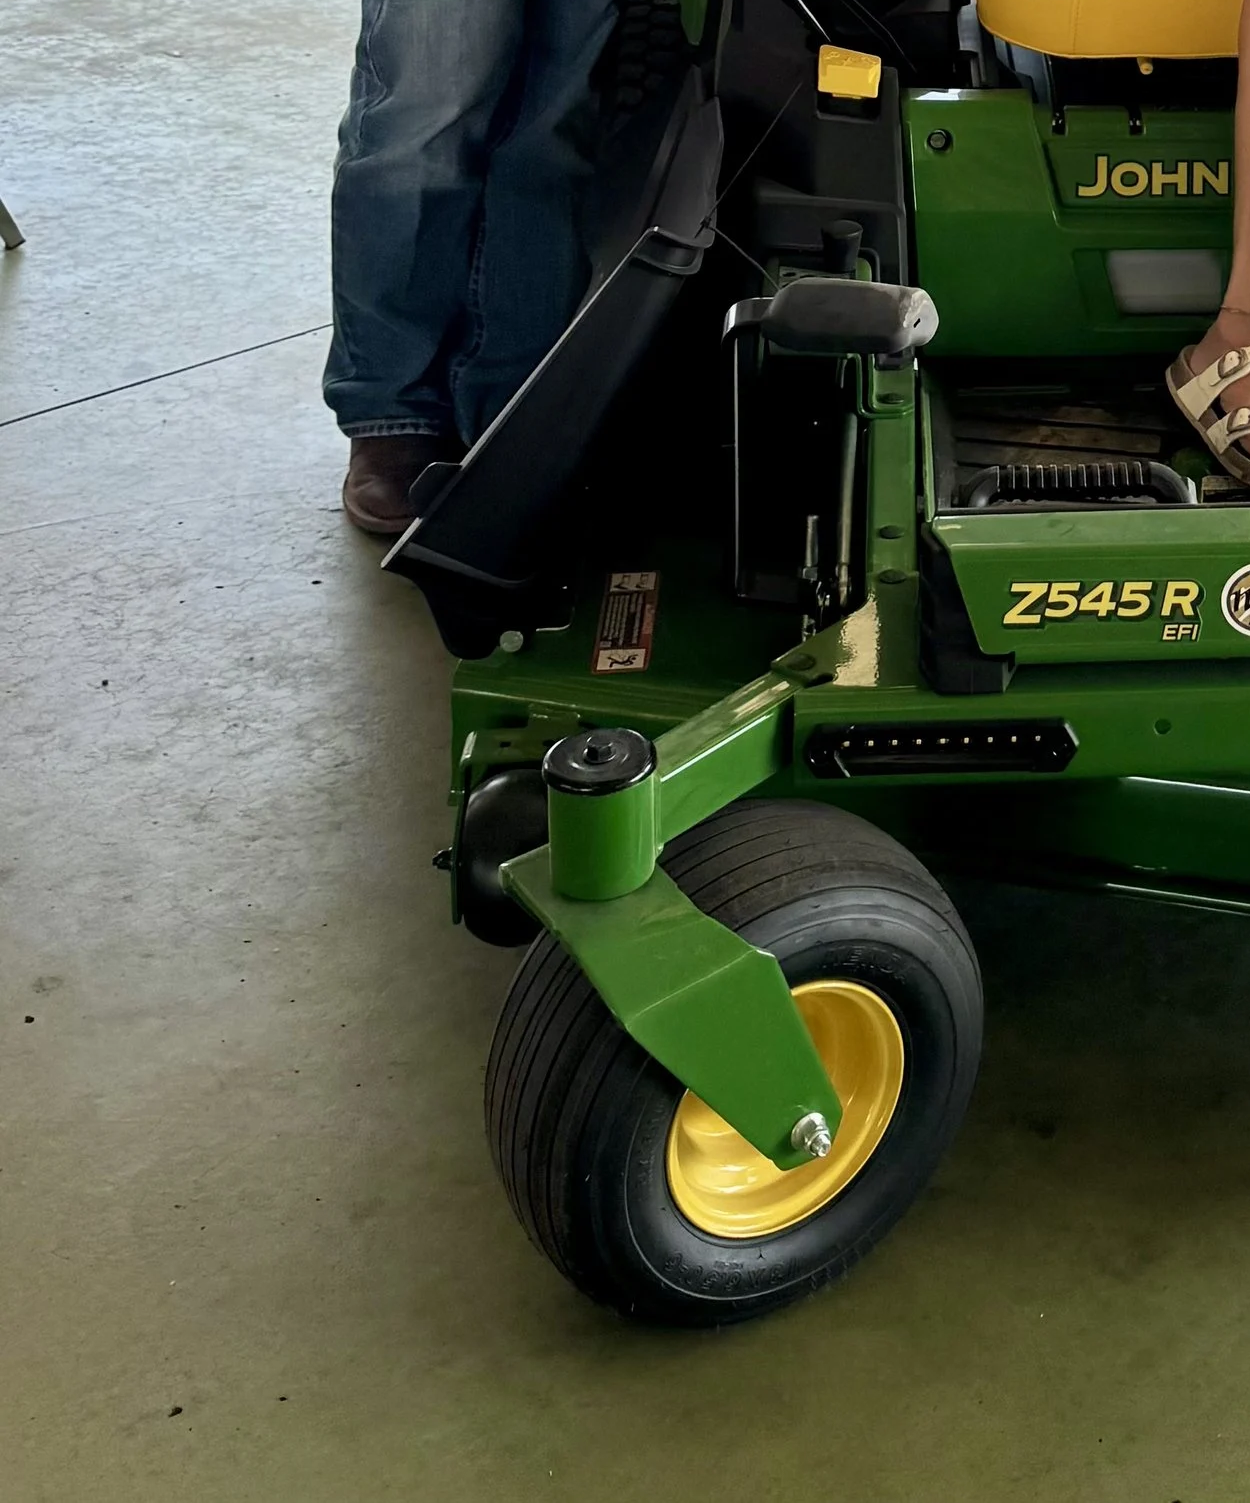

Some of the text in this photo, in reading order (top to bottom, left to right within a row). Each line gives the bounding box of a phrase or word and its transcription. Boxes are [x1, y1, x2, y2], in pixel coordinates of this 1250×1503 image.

[1077, 155, 1229, 197] JOHN
[1003, 580, 1199, 626] Z545 R
[1162, 623, 1199, 641] EFI
